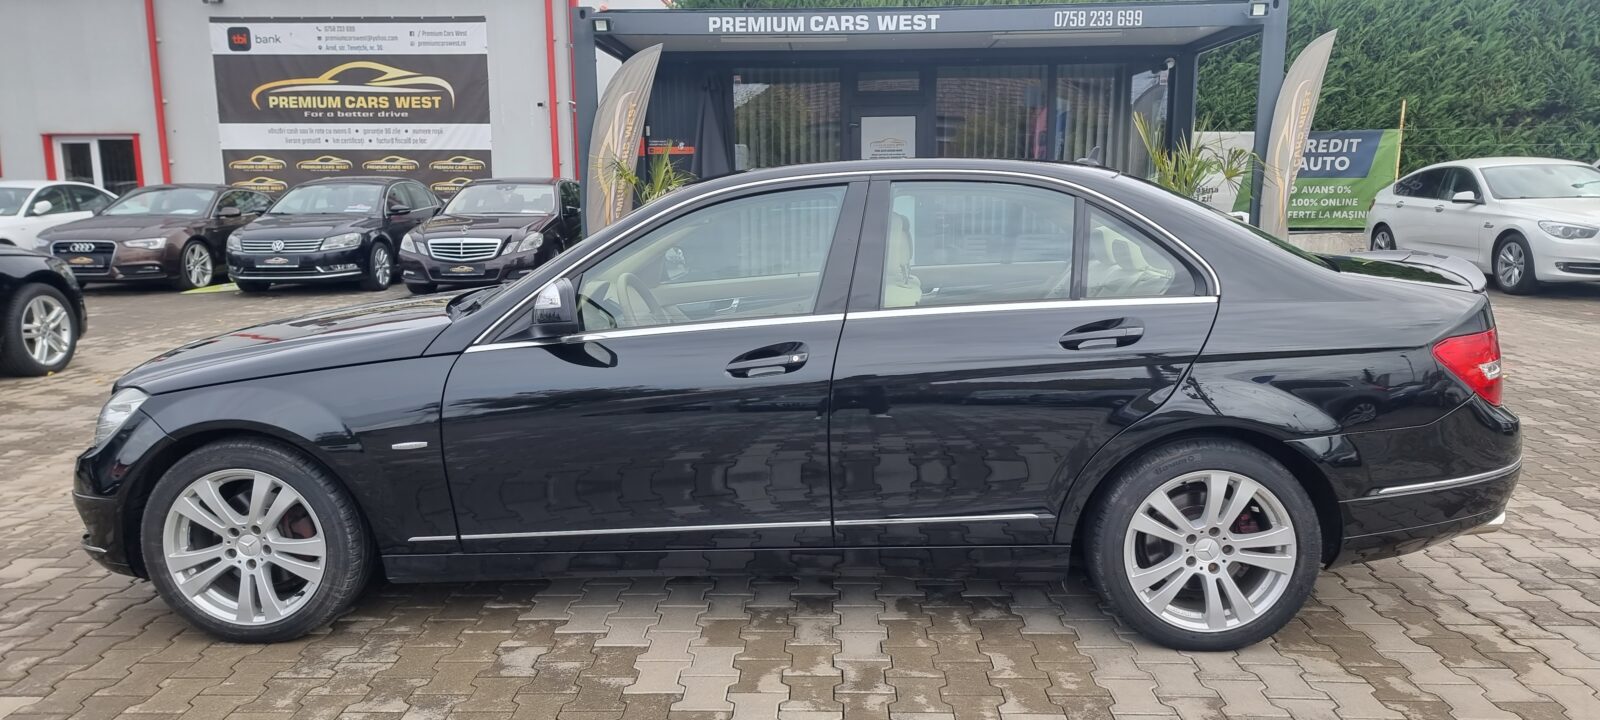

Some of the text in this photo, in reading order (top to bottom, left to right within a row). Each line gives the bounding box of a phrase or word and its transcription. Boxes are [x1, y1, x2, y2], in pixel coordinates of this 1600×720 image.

[708, 14, 940, 33] PREMIUM CARS WEST
[1054, 10, 1143, 27] 0758 233 699
[231, 34, 247, 45] tbi
[255, 34, 281, 44] bank
[268, 96, 441, 109] PREMIUM CARS WEST
[624, 102, 637, 138] WEST
[1305, 138, 1362, 153] REDIT
[1300, 156, 1350, 171] AUTO
[1301, 185, 1352, 194] AVANS 0%
[1291, 198, 1359, 207] 100% ONLINE
[1287, 210, 1317, 219] FERTE
[1319, 210, 1331, 219] LA
